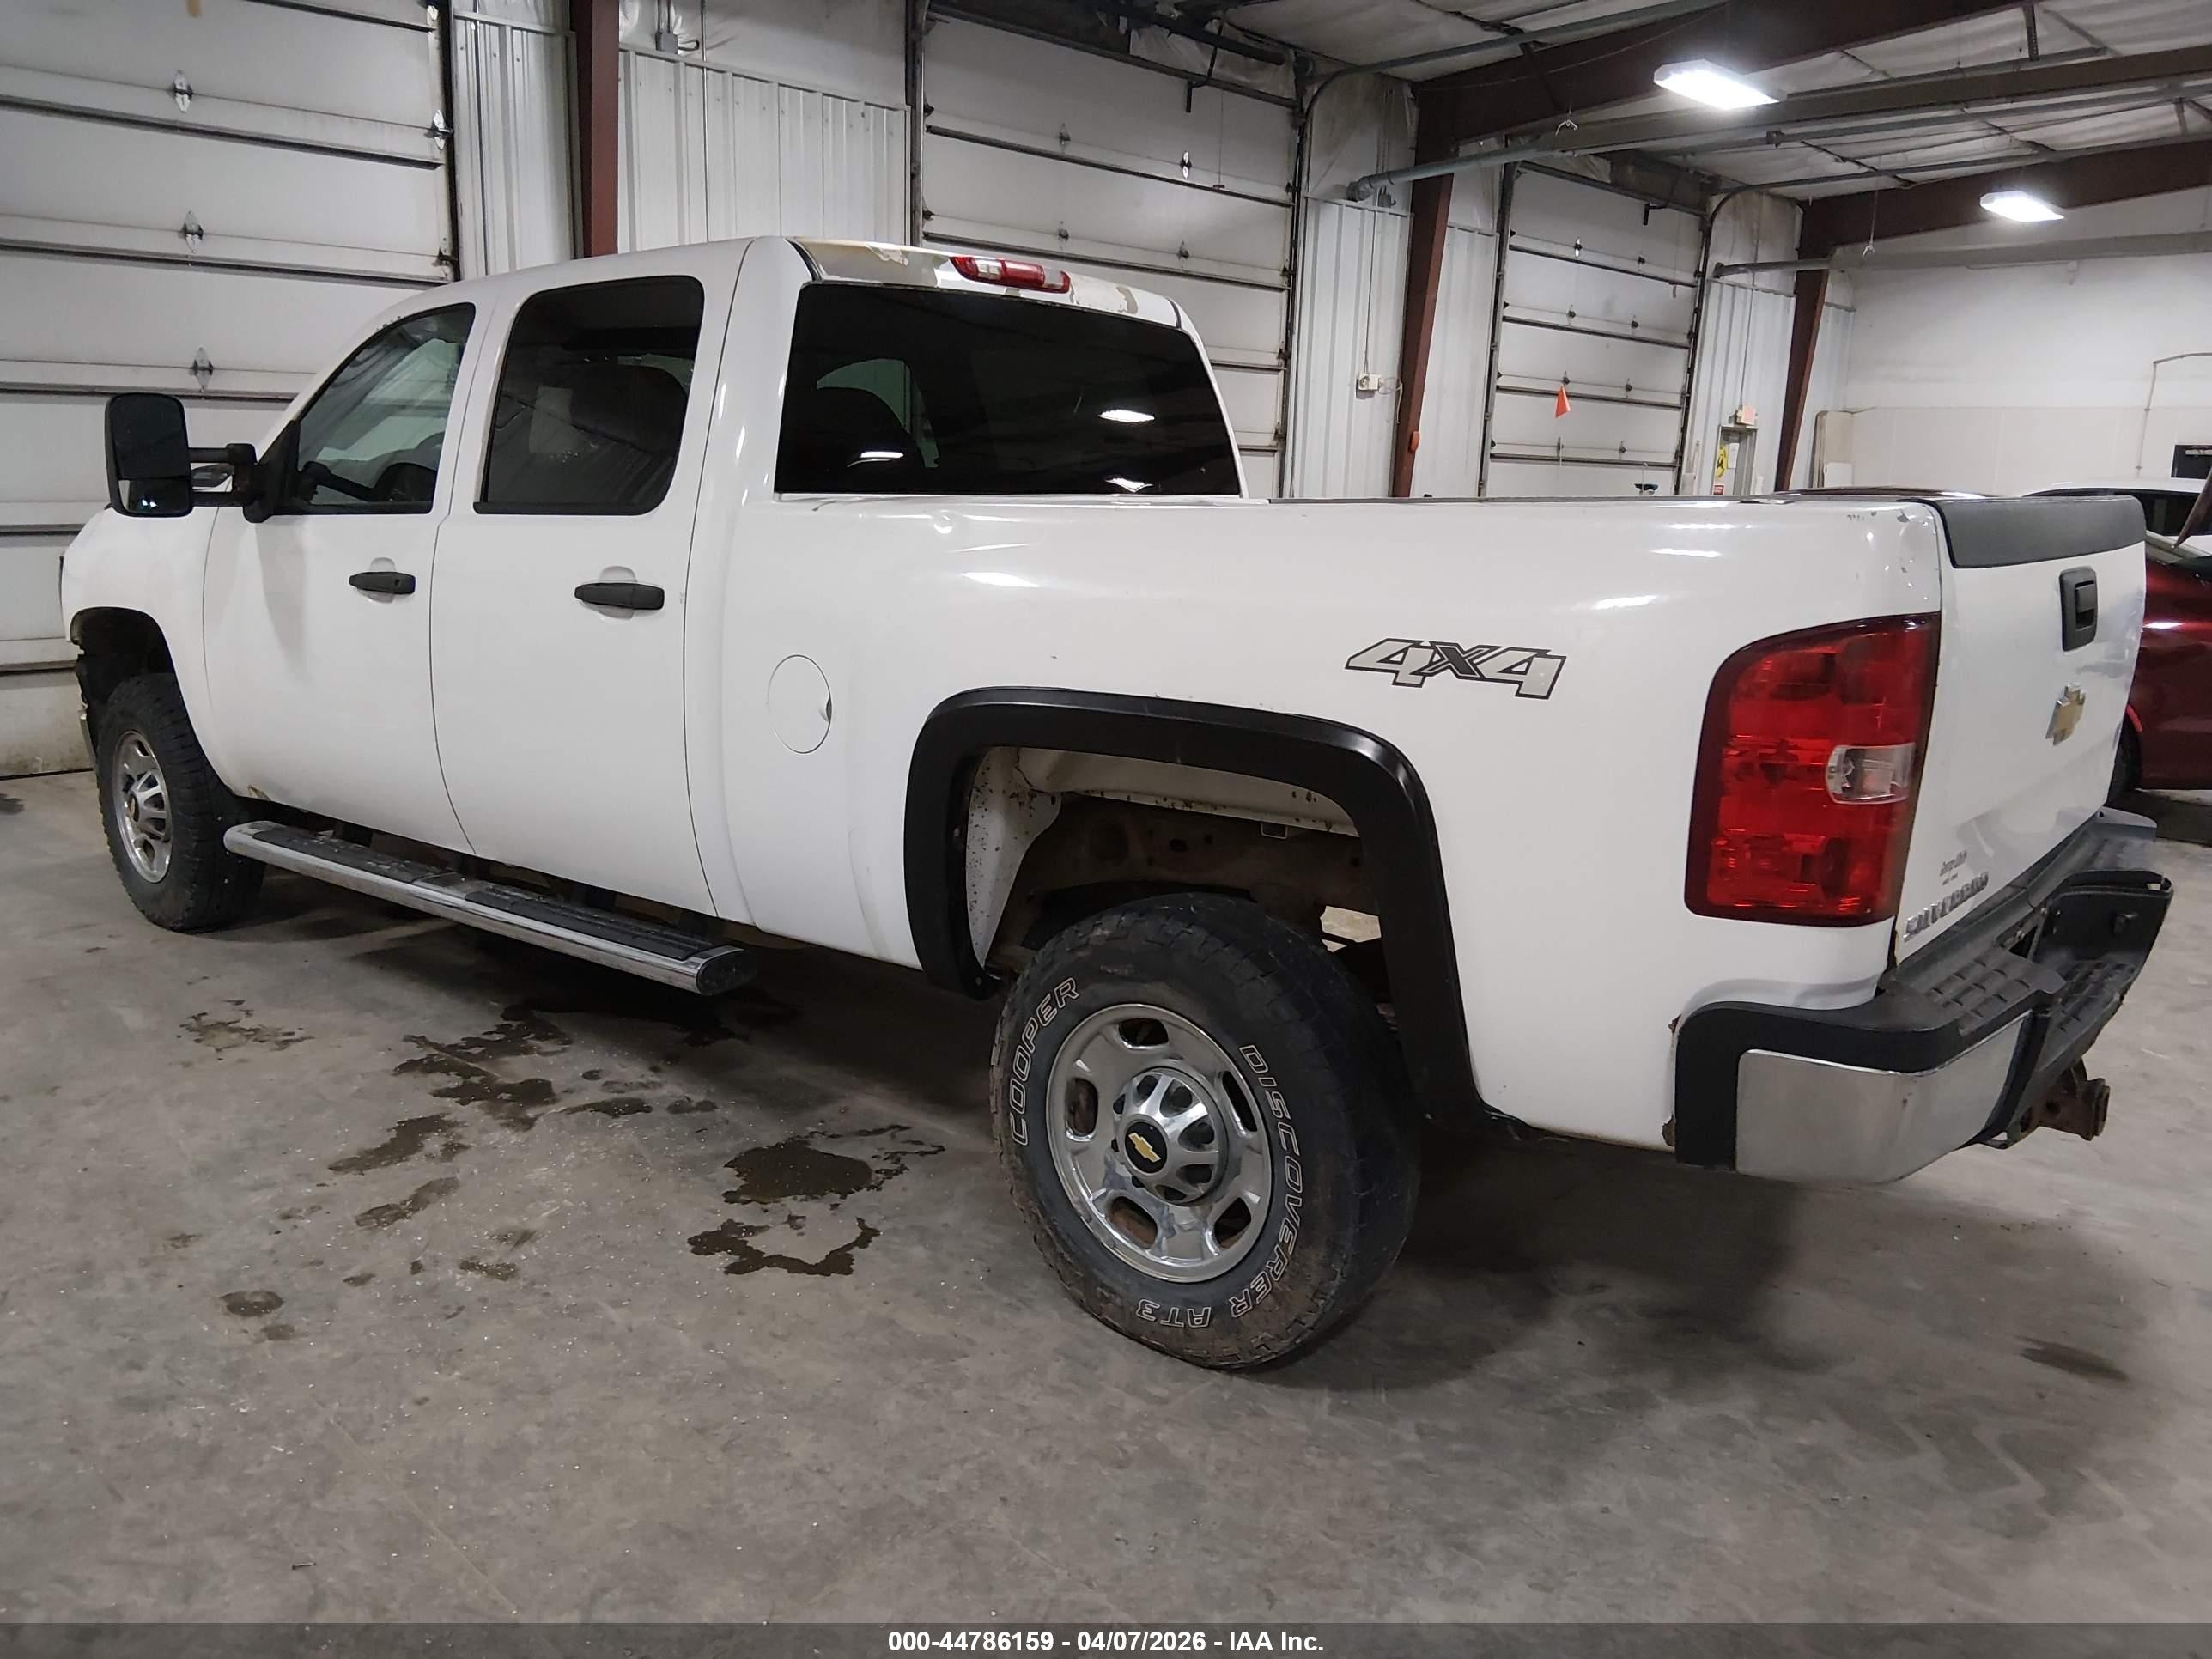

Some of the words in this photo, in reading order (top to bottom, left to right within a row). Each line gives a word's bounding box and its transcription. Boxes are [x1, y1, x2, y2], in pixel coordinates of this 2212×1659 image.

[1007, 977, 1079, 1147] COOPER
[1231, 1044, 1304, 1319] DISCOVERER
[1135, 1297, 1212, 1328] AT3
